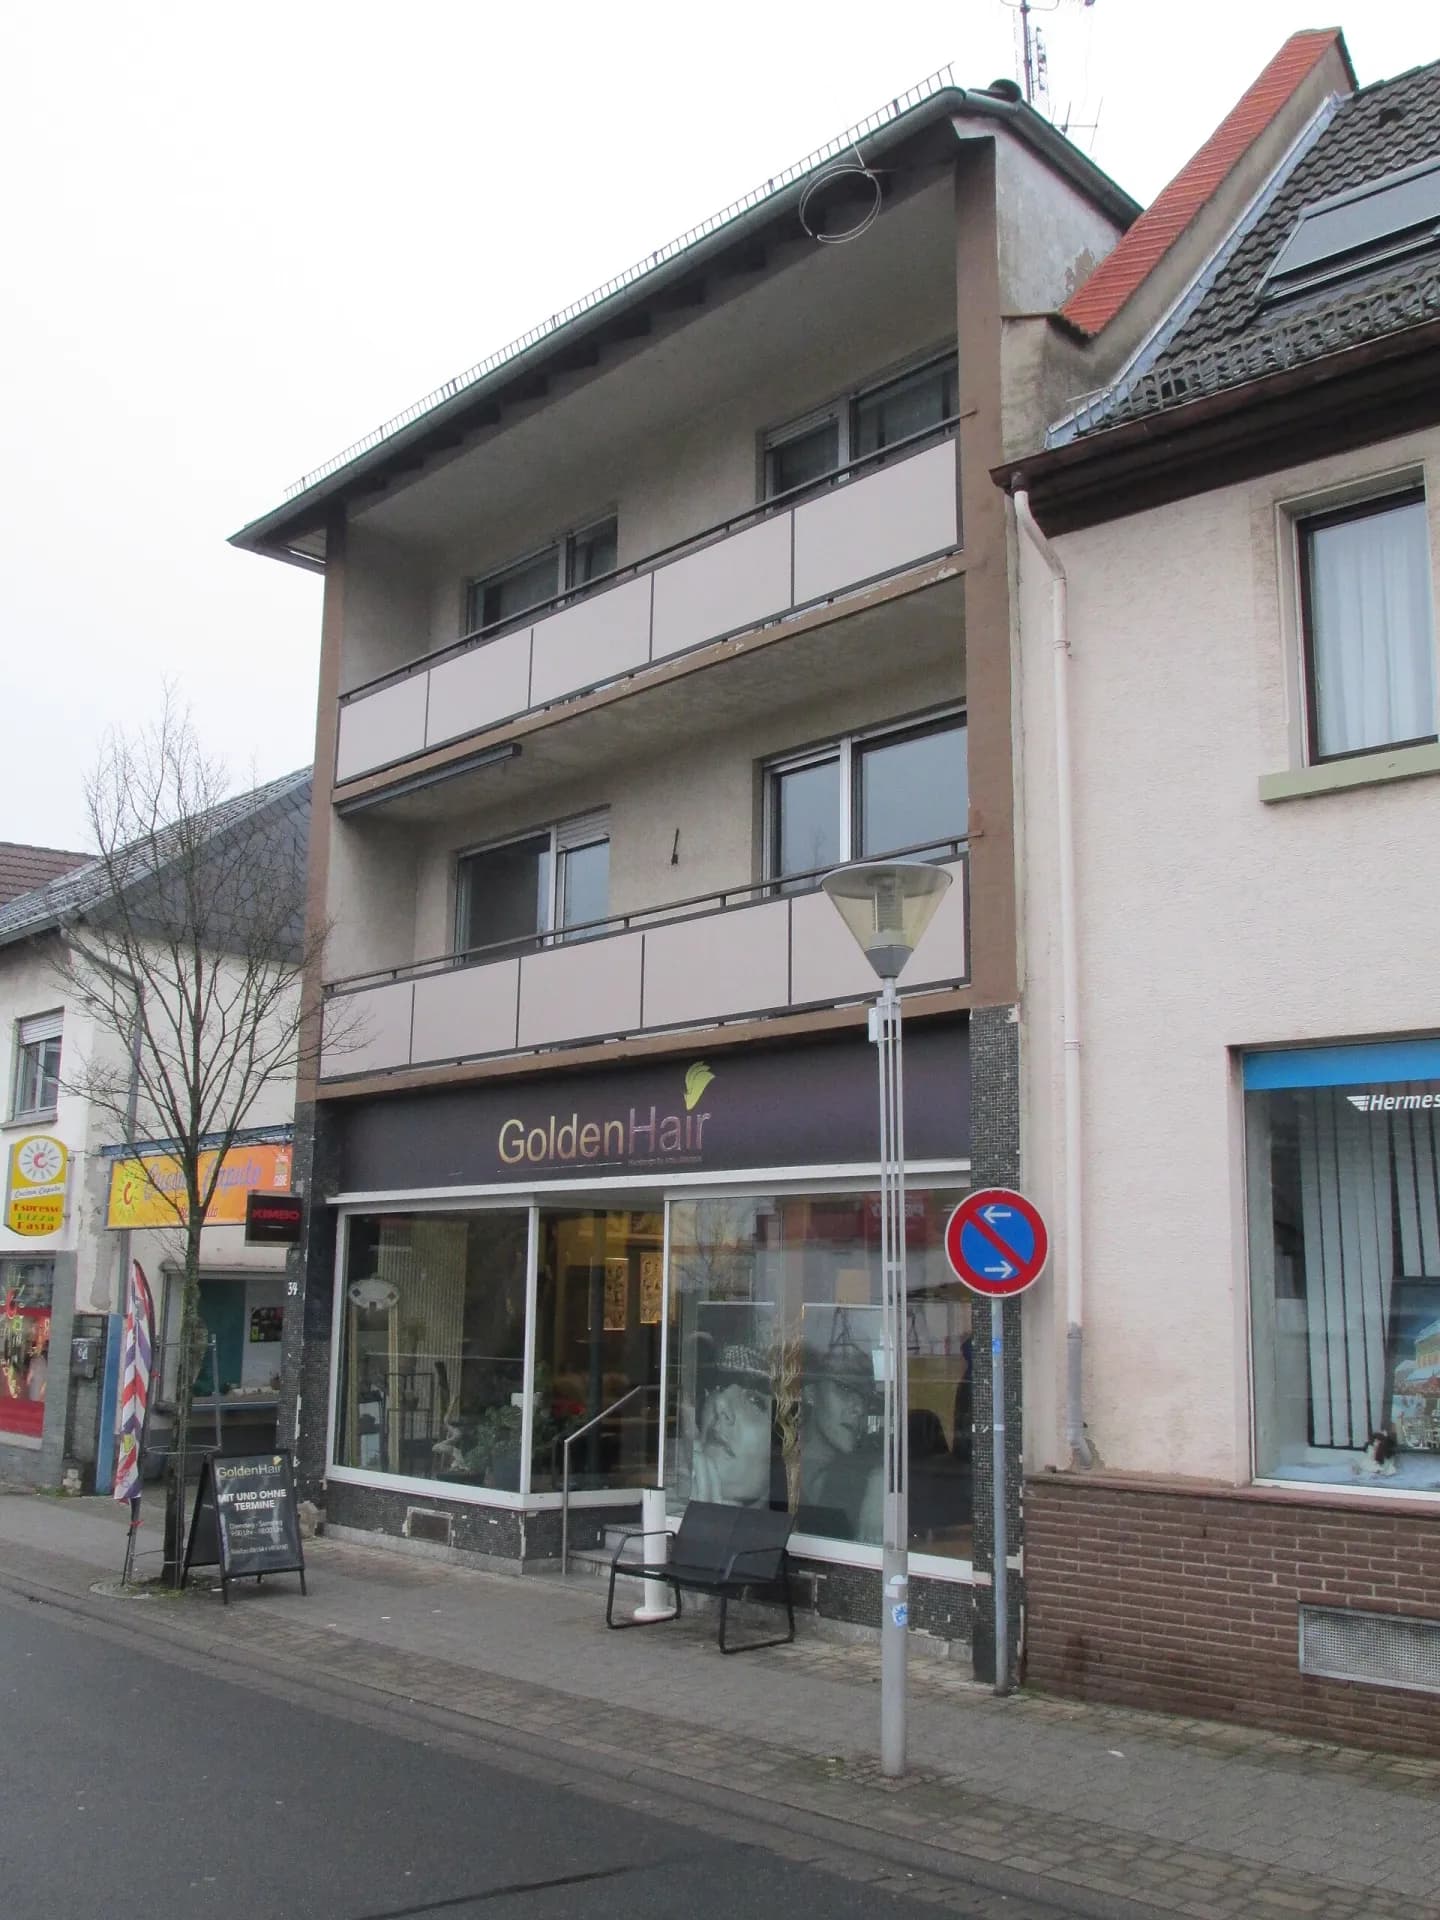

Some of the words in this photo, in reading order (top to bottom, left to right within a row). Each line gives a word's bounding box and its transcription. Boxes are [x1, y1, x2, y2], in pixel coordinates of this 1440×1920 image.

[1370, 1094, 1440, 1111] Hermes
[498, 1105, 713, 1164] GoldenHair
[216, 1464, 281, 1478] GoldenHair
[217, 1493, 235, 1503] MIT
[236, 1491, 258, 1501] UND
[259, 1489, 287, 1500] OHNE
[234, 1500, 276, 1510] TERMINE
